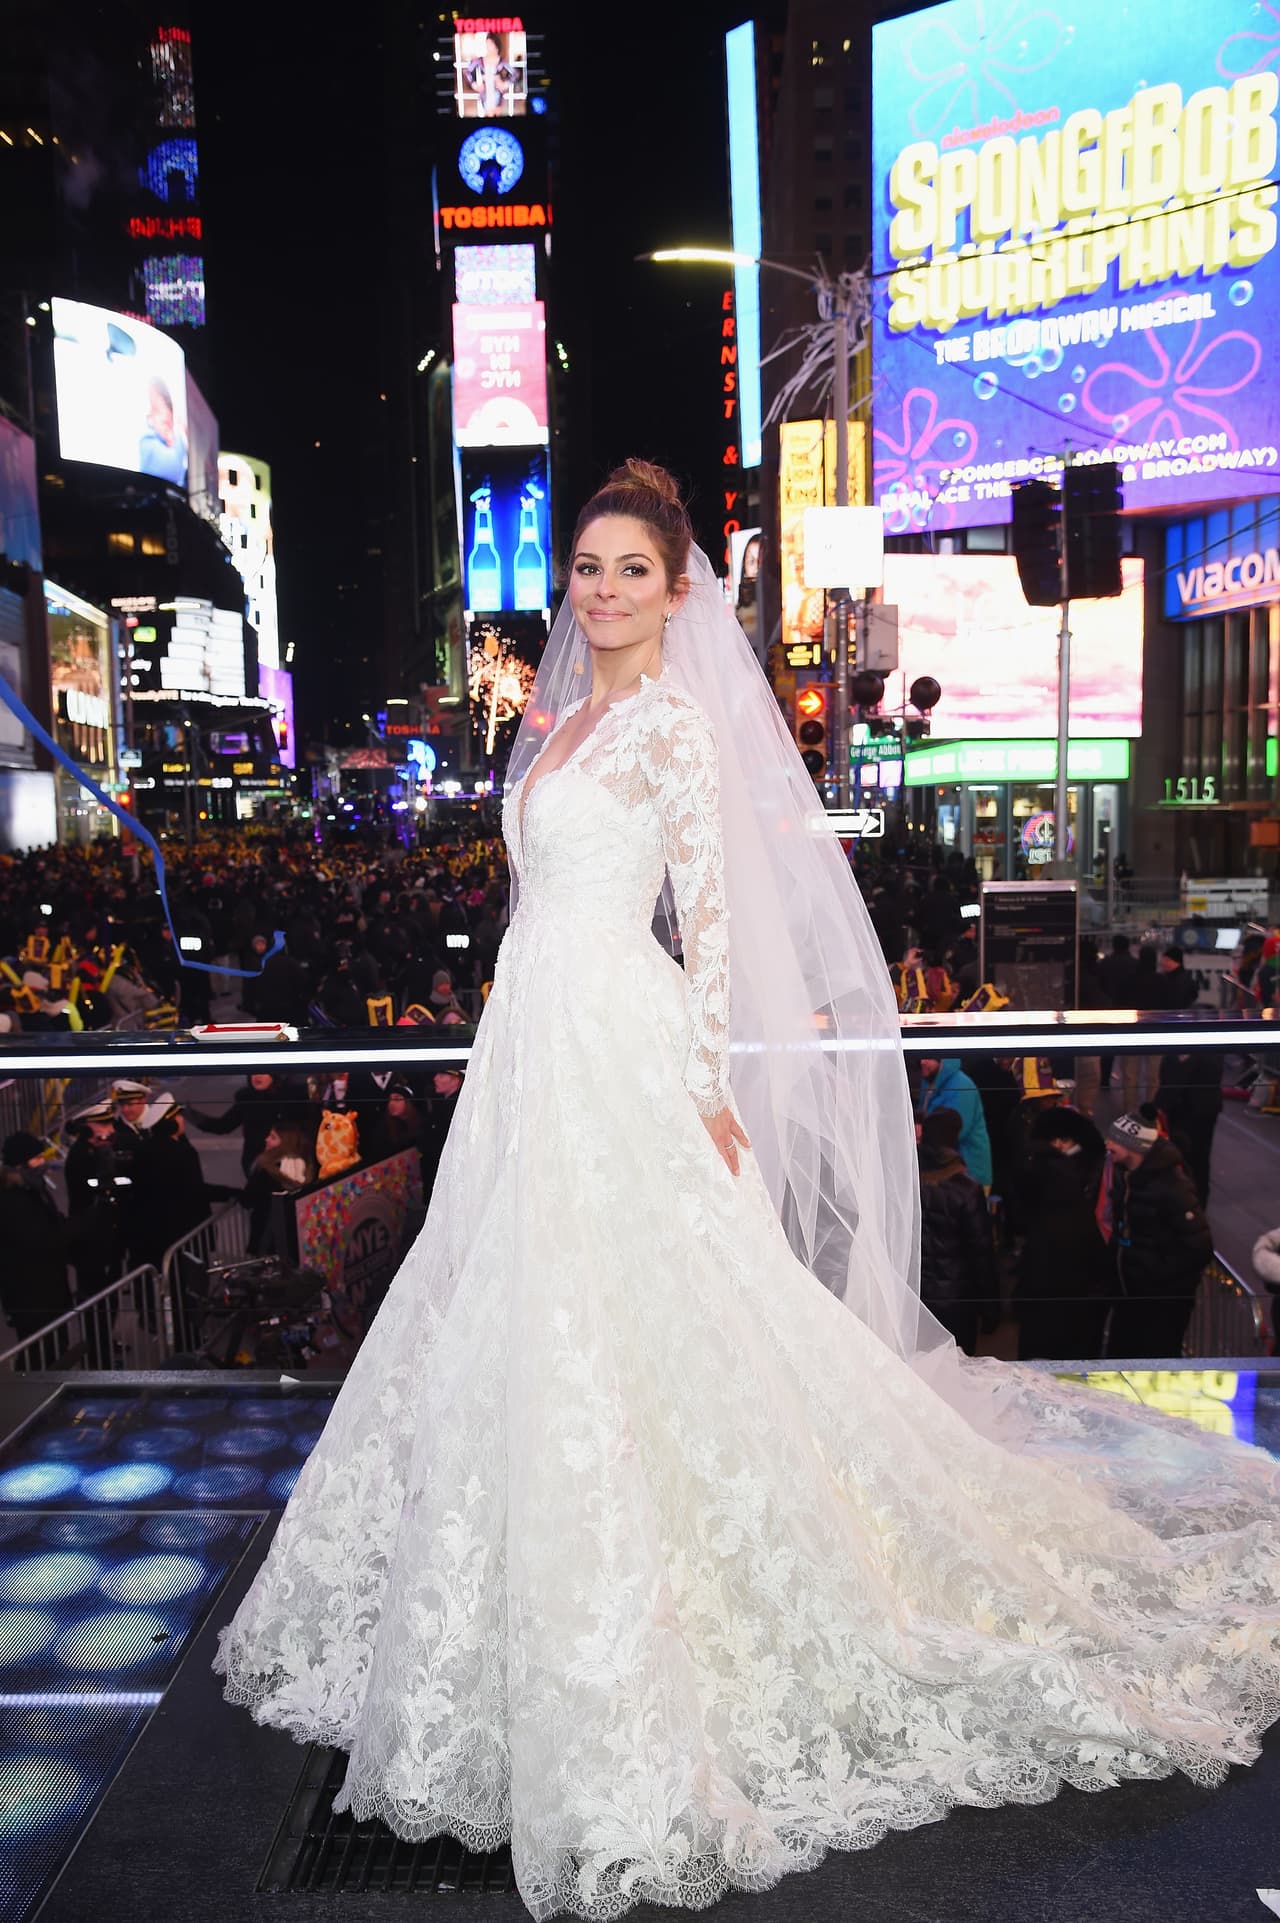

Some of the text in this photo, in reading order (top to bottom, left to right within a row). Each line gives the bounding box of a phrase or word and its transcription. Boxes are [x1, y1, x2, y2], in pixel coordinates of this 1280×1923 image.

[453, 16, 524, 33] TOSHIBA
[889, 71, 1280, 259] SPONGEBOB
[440, 204, 547, 229] TOSHIBA
[888, 178, 1279, 333] SQUAREPANTS
[934, 292, 1216, 365] THE BROADWAY MUSICAL
[720, 290, 740, 466] ERNST &
[1142, 446, 1278, 480] BROADWAY)
[386, 724, 440, 735] TOSHA
[1164, 776, 1216, 801] 1515
